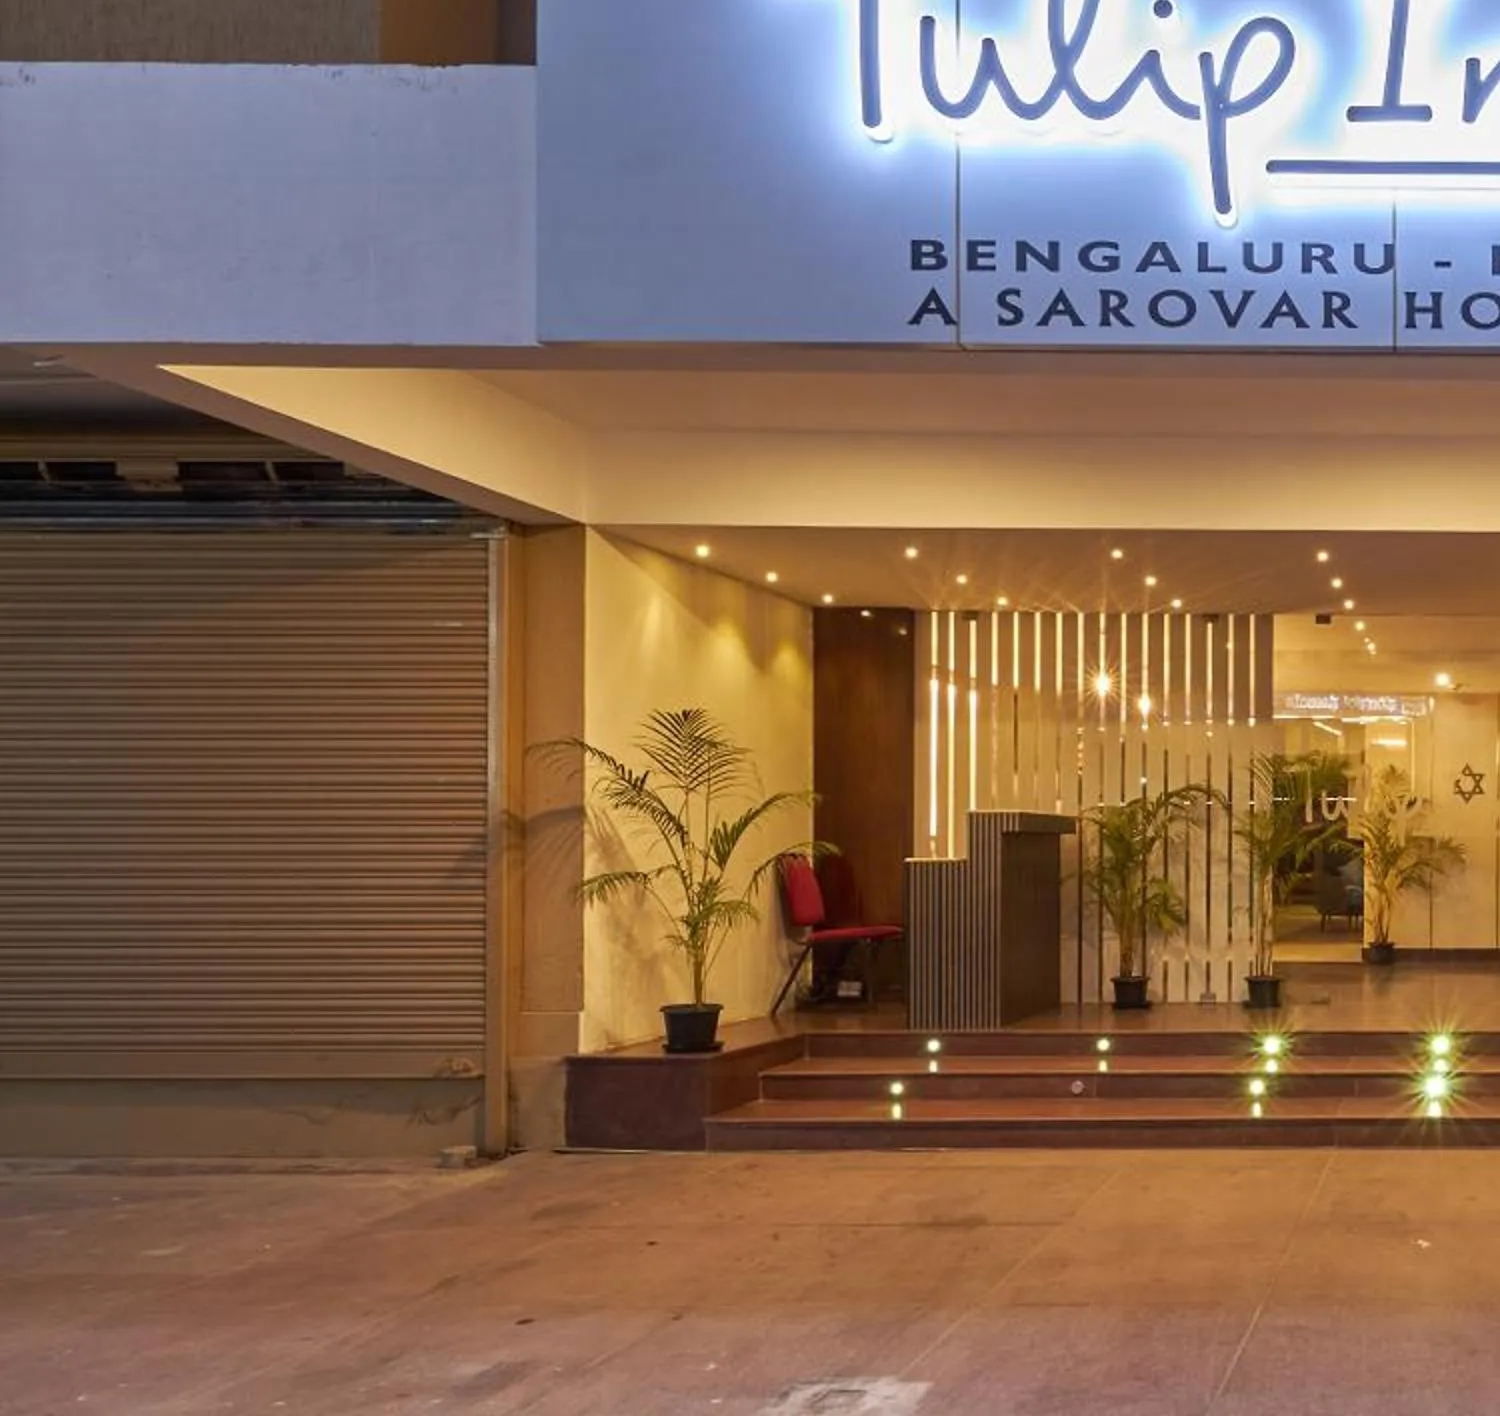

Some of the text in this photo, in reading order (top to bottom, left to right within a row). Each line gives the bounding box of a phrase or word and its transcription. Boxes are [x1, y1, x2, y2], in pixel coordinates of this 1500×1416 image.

[909, 239, 1396, 275] BENGALURU
[907, 286, 958, 327] A
[996, 287, 1361, 330] SAROVAR
